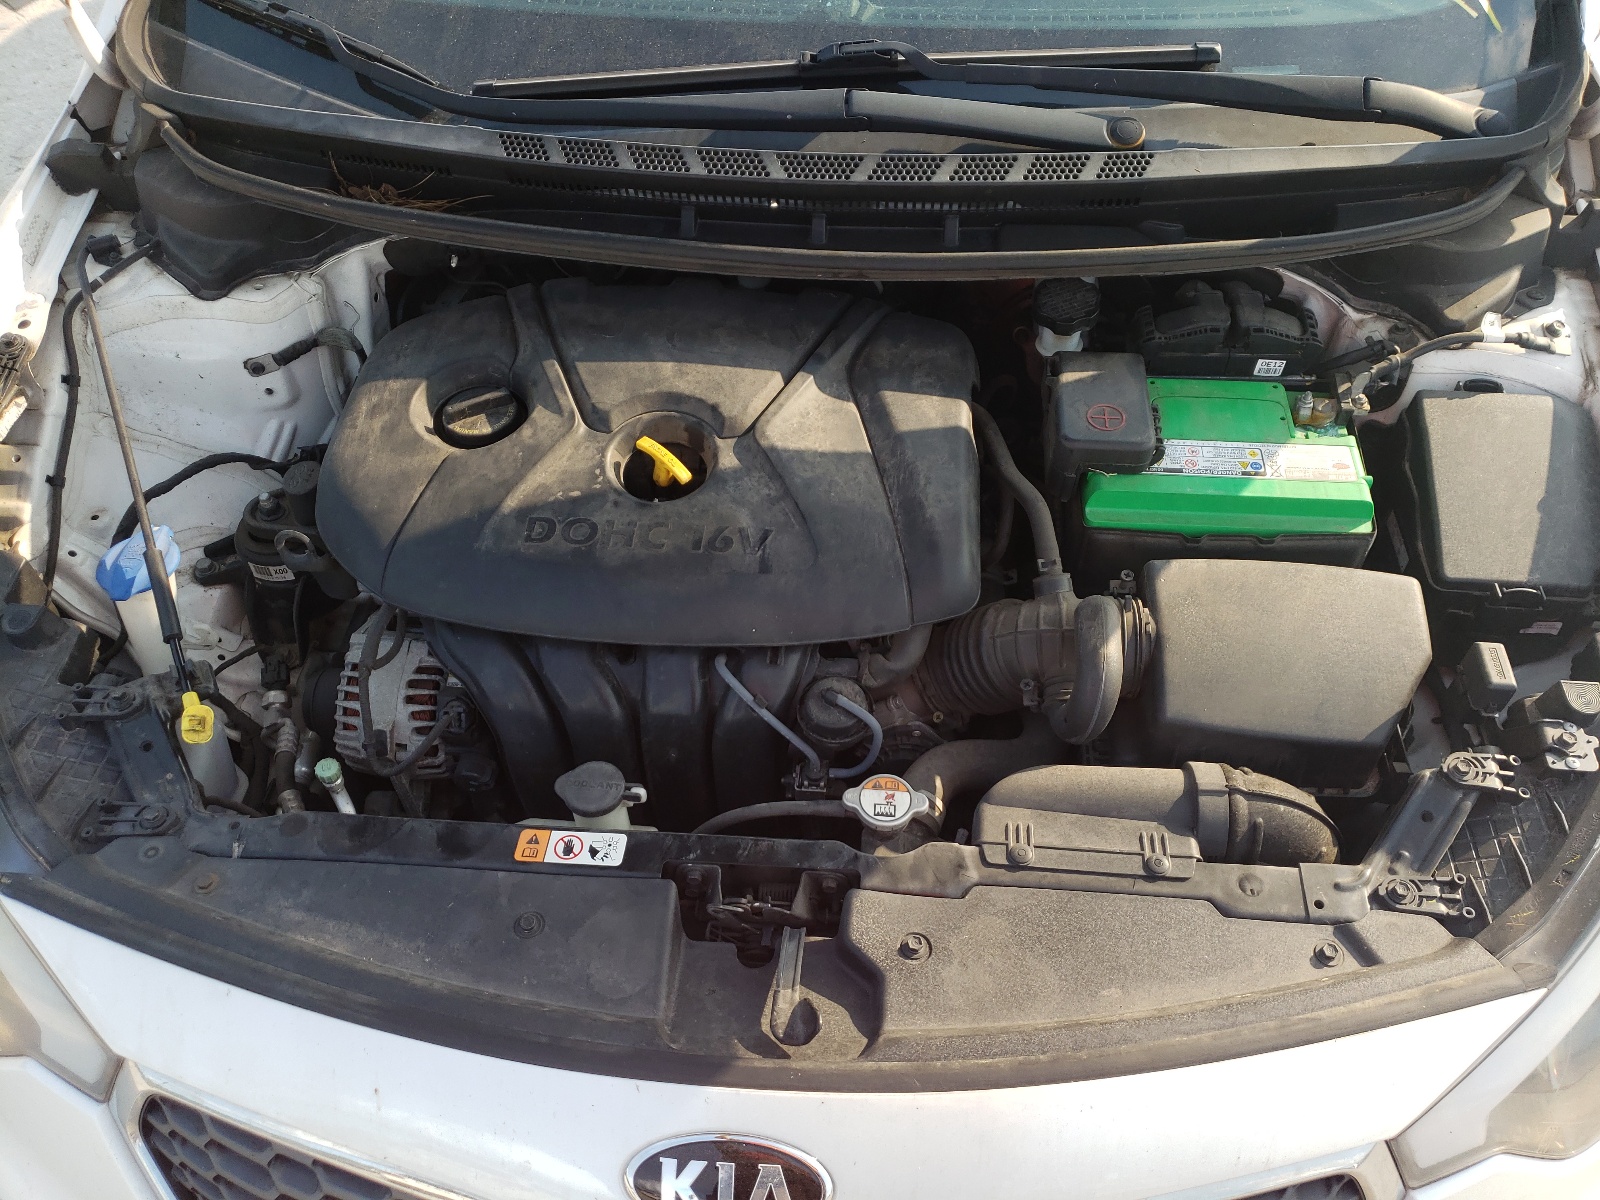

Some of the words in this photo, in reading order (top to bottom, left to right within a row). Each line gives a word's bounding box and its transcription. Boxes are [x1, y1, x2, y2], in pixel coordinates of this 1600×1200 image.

[523, 516, 672, 550] DOHC
[690, 524, 775, 556] 16V
[659, 1156, 793, 1200] KIA
